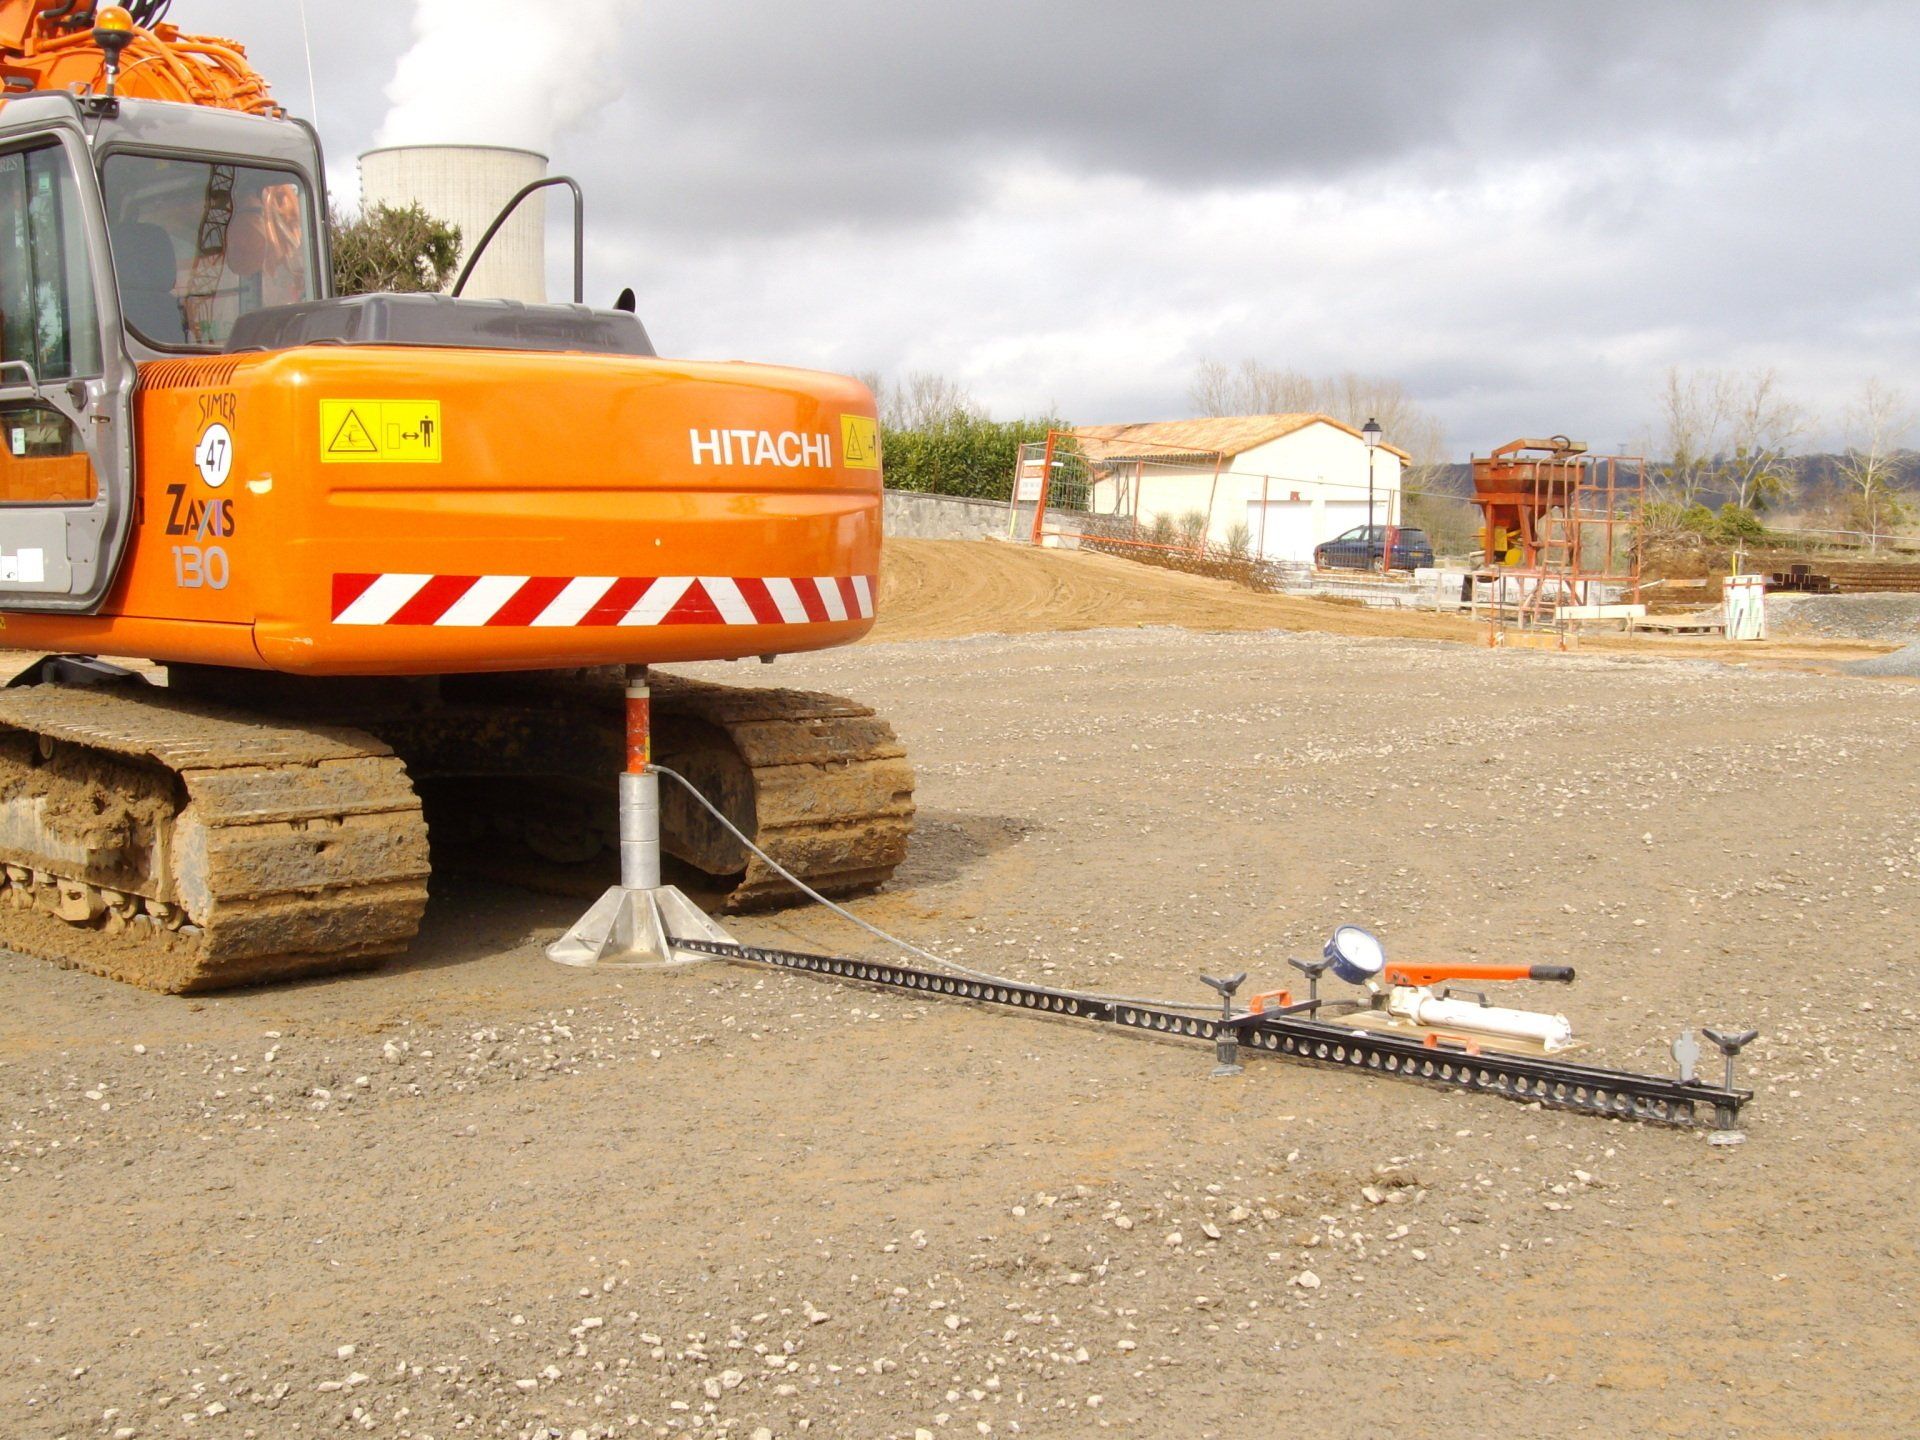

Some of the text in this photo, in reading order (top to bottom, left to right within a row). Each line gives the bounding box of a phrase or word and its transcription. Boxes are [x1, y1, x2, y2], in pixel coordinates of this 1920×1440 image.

[197, 392, 237, 432] SIMER
[206, 439, 226, 472] 47
[689, 428, 832, 468] HITACHI
[172, 545, 229, 590] 130
